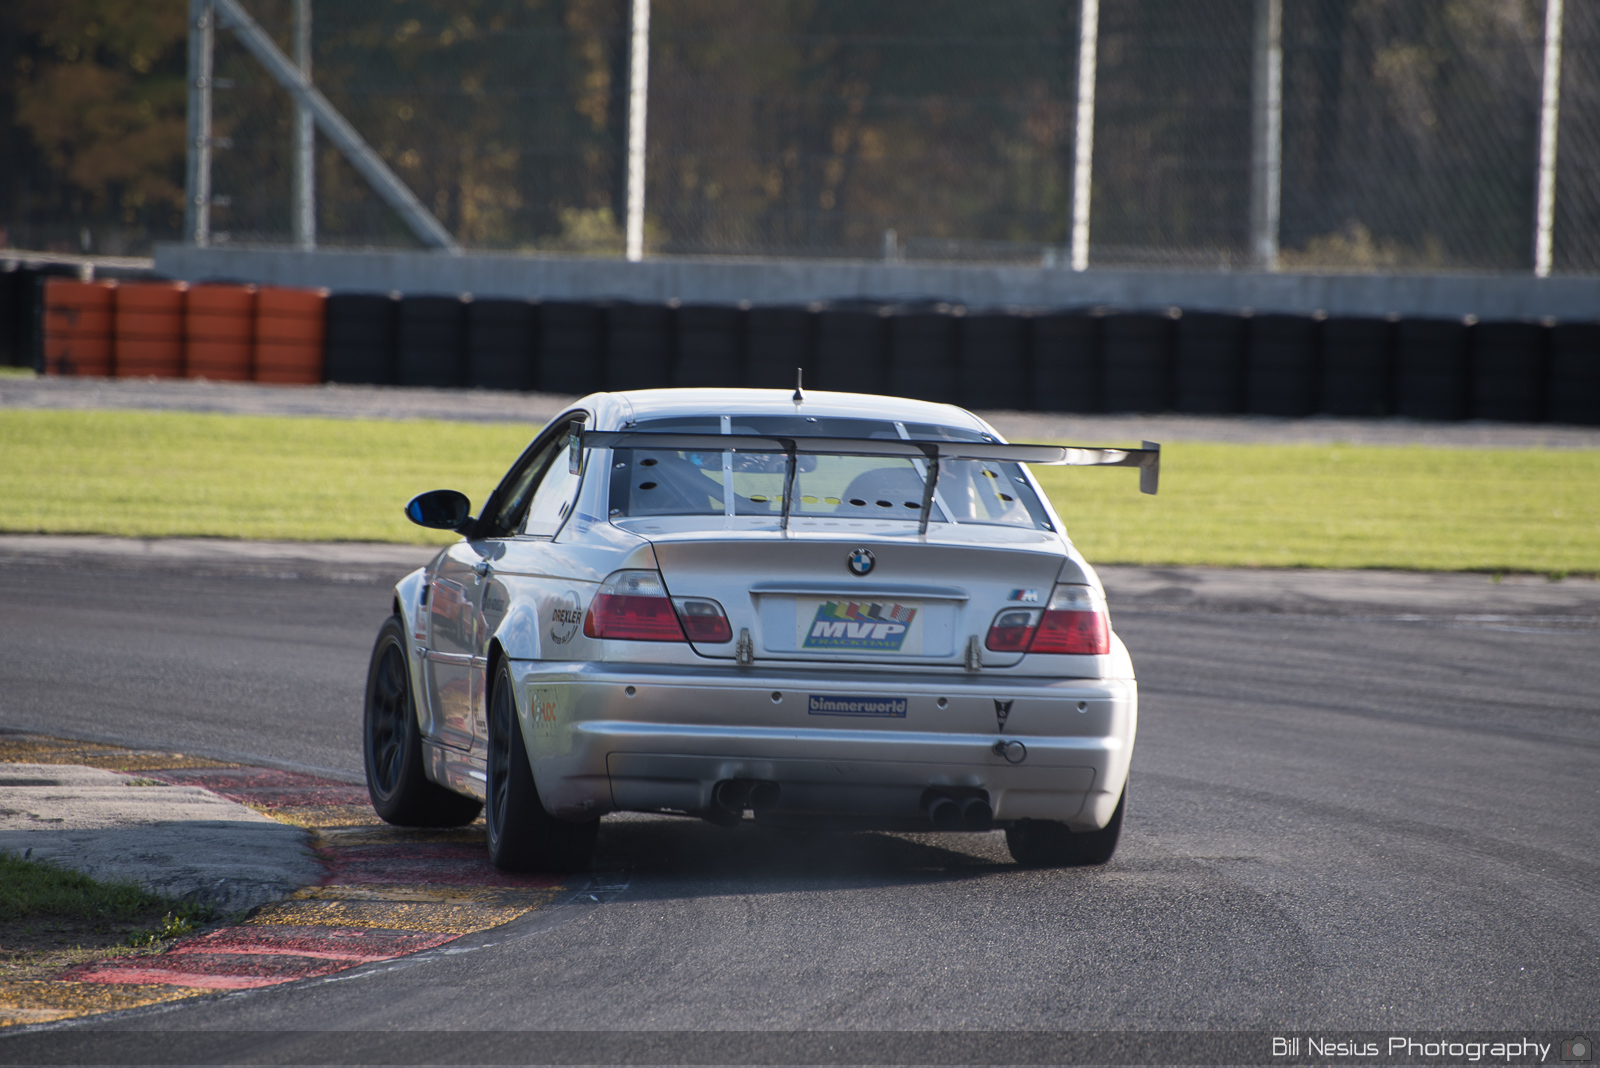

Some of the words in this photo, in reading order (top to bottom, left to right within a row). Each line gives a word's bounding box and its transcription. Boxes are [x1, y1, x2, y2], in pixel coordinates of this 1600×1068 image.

[552, 609, 582, 626] DREXLER
[810, 621, 906, 639] MVP
[809, 638, 899, 648] TRACKTIME
[810, 697, 906, 713] bimmerworld
